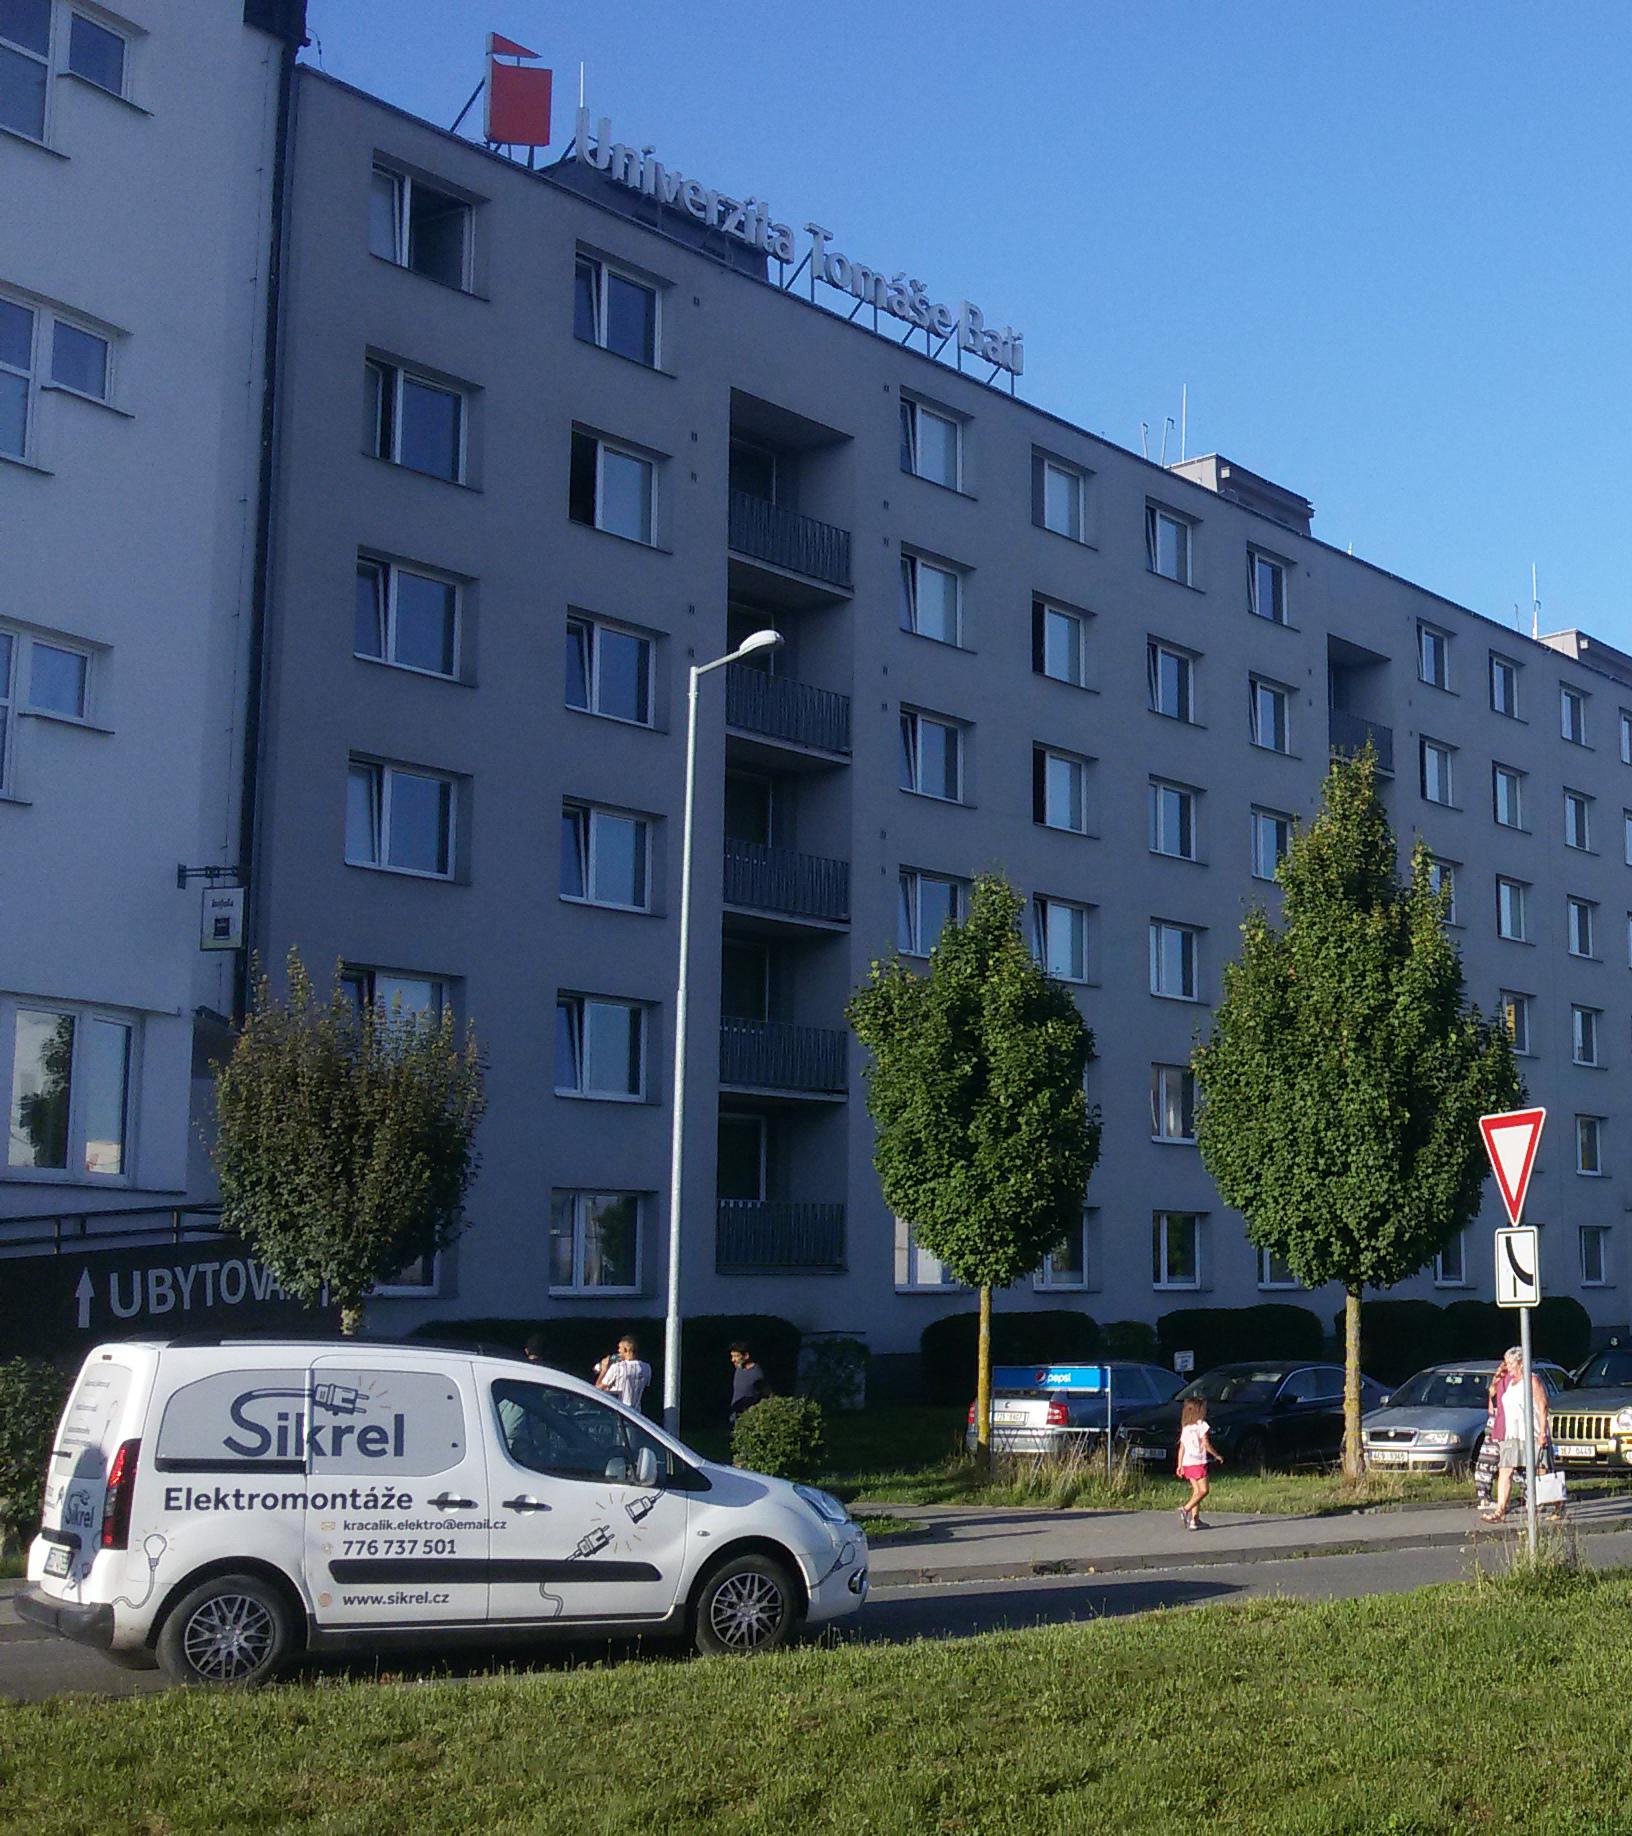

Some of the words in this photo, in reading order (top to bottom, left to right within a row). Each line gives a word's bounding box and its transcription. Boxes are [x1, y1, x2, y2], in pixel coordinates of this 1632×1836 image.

[576, 107, 795, 265] Univerzita
[803, 222, 952, 340] Tomáše
[958, 300, 1024, 376] Bati
[1047, 1373, 1072, 1384] pepsi
[223, 1387, 405, 1458] Sikrel
[164, 1486, 413, 1511] Elektromontáže
[343, 1519, 507, 1531] kracalik.elektro@email.cz
[342, 1540, 379, 1556] 776
[383, 1540, 419, 1556] 737
[422, 1539, 457, 1555] 501
[342, 1591, 450, 1606] www.sikrel.cz
